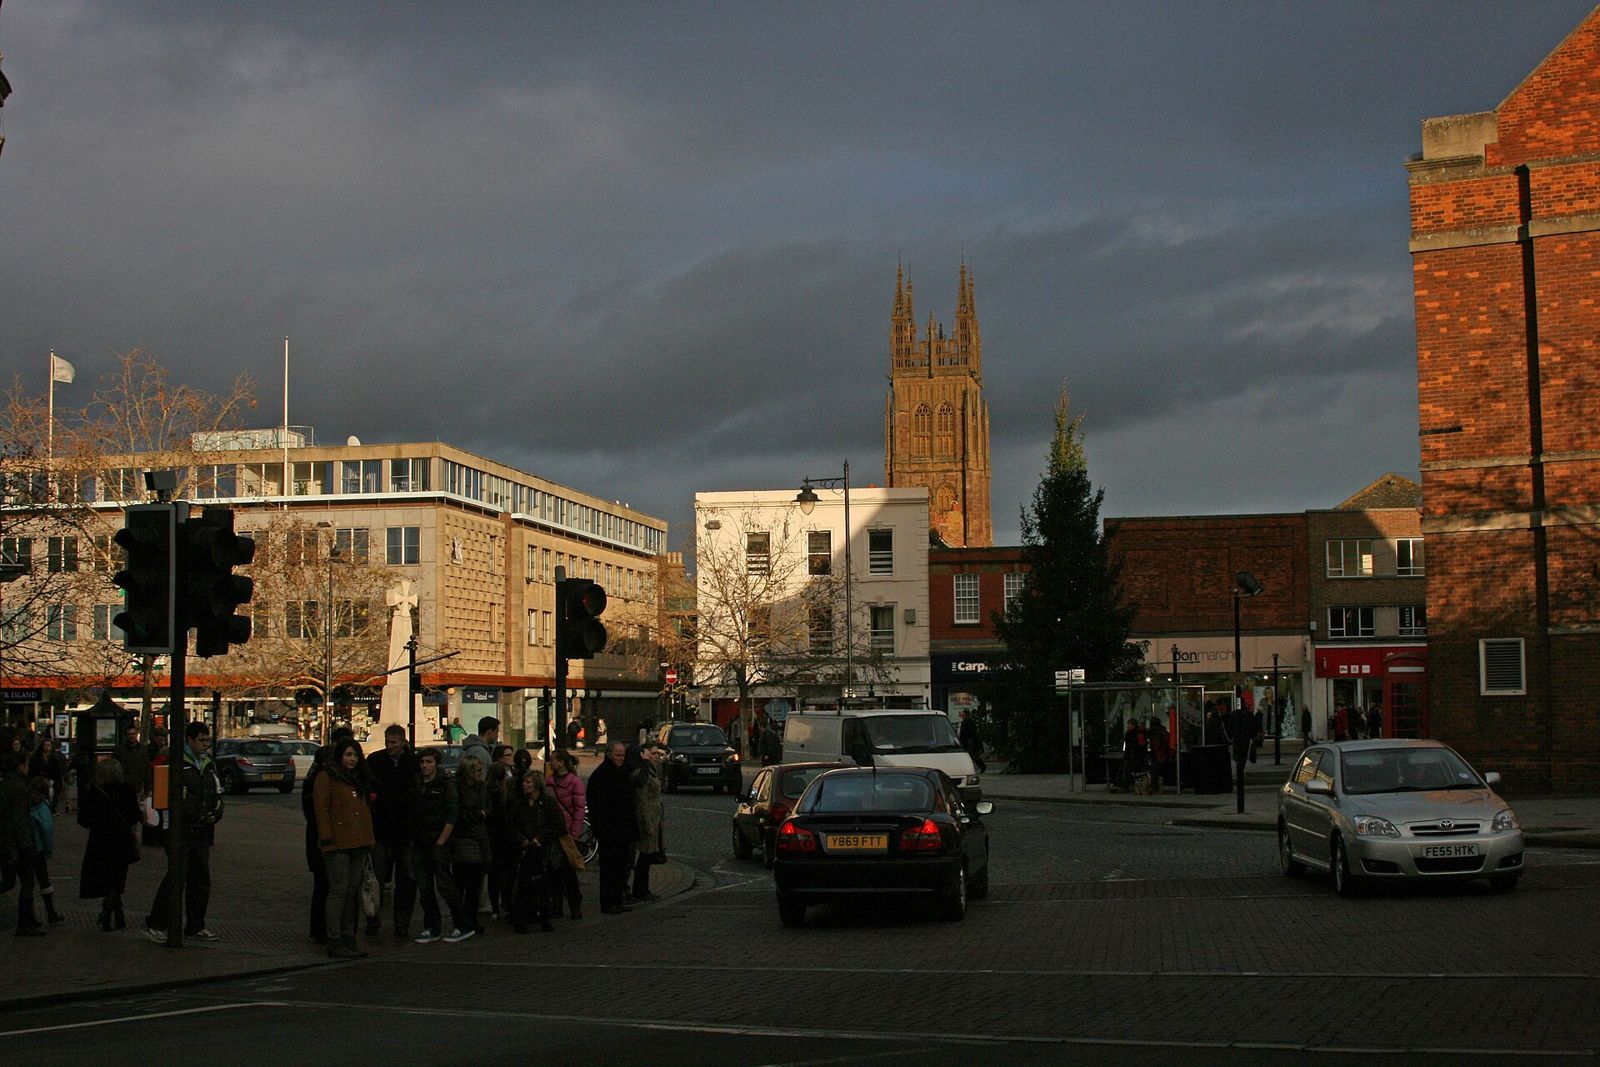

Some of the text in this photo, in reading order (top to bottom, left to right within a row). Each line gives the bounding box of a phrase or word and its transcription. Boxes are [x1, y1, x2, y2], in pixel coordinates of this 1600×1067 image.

[1173, 648, 1237, 662] bonmarch
[831, 836, 882, 847] Y869 FTT
[1425, 845, 1474, 857] FE55 HTK
